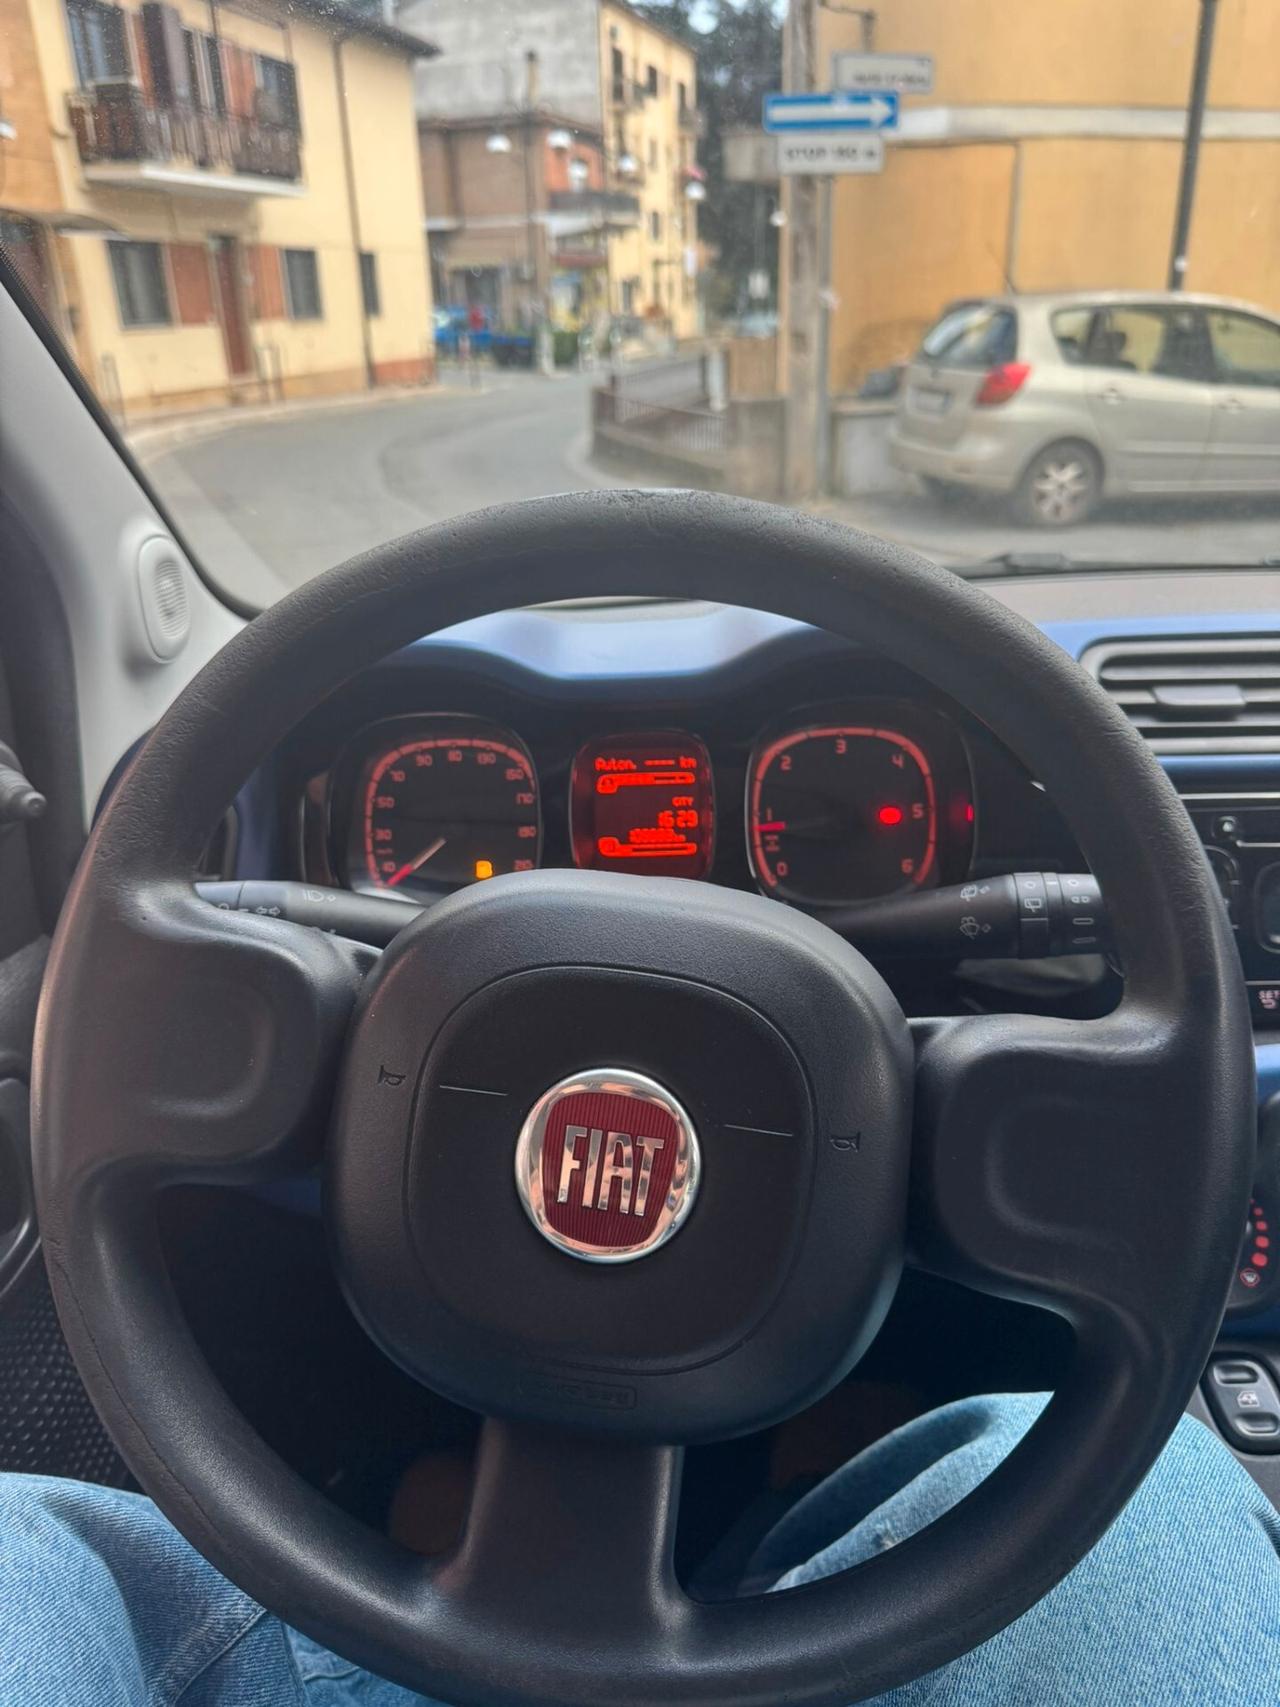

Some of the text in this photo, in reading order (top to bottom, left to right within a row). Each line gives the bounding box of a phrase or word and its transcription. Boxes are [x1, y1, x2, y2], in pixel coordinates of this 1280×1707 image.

[835, 738, 848, 754] 3
[780, 755, 792, 770] 2
[892, 754, 904, 768] 4
[912, 803, 924, 819] 5
[776, 861, 789, 876] 0
[901, 858, 914, 874] 6
[1258, 989, 1280, 1000] SET
[556, 1124, 665, 1217] FIAT
